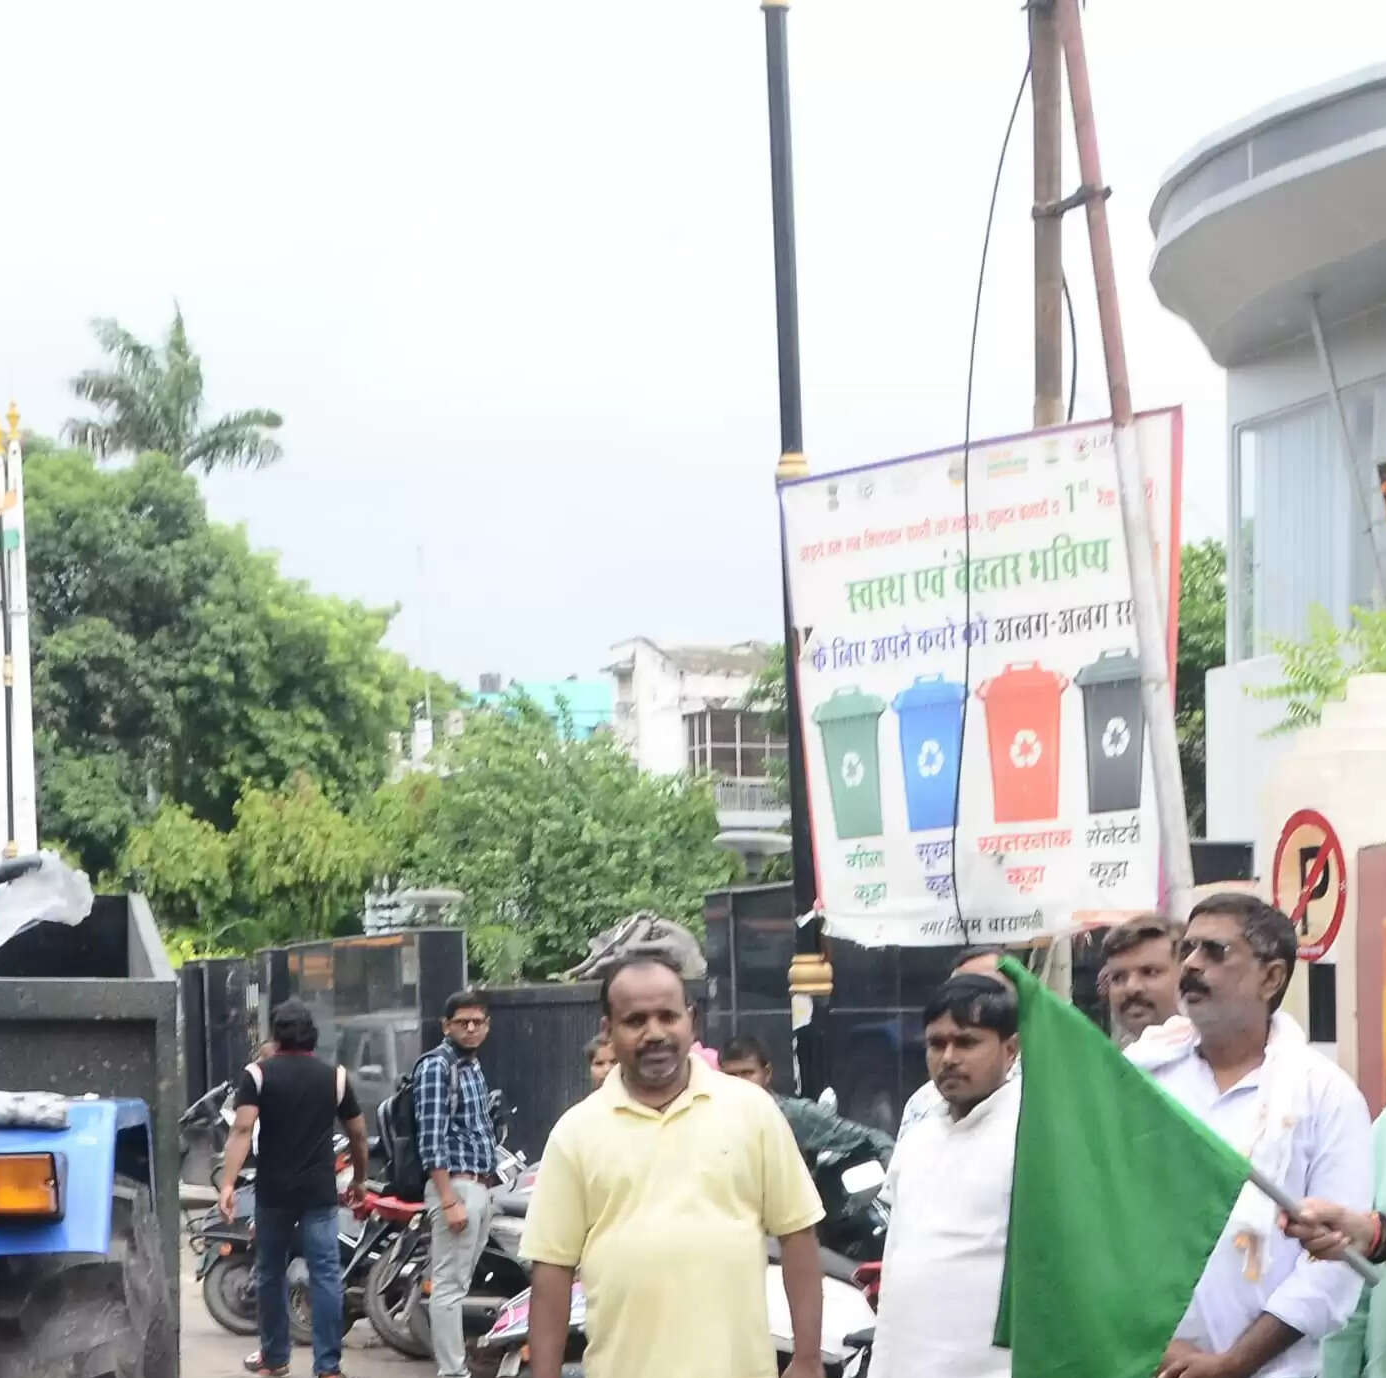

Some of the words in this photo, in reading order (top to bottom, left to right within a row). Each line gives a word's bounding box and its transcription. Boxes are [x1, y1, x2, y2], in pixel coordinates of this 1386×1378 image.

[846, 572, 906, 613] स्वस्थ
[912, 549, 945, 602] एवं
[954, 549, 1022, 594] बेहतर
[1028, 532, 1111, 581] भविष्य
[832, 636, 866, 669] लिए
[870, 623, 912, 662] अपने
[917, 615, 956, 654] कचरे
[994, 603, 1109, 642] अलग-अलग
